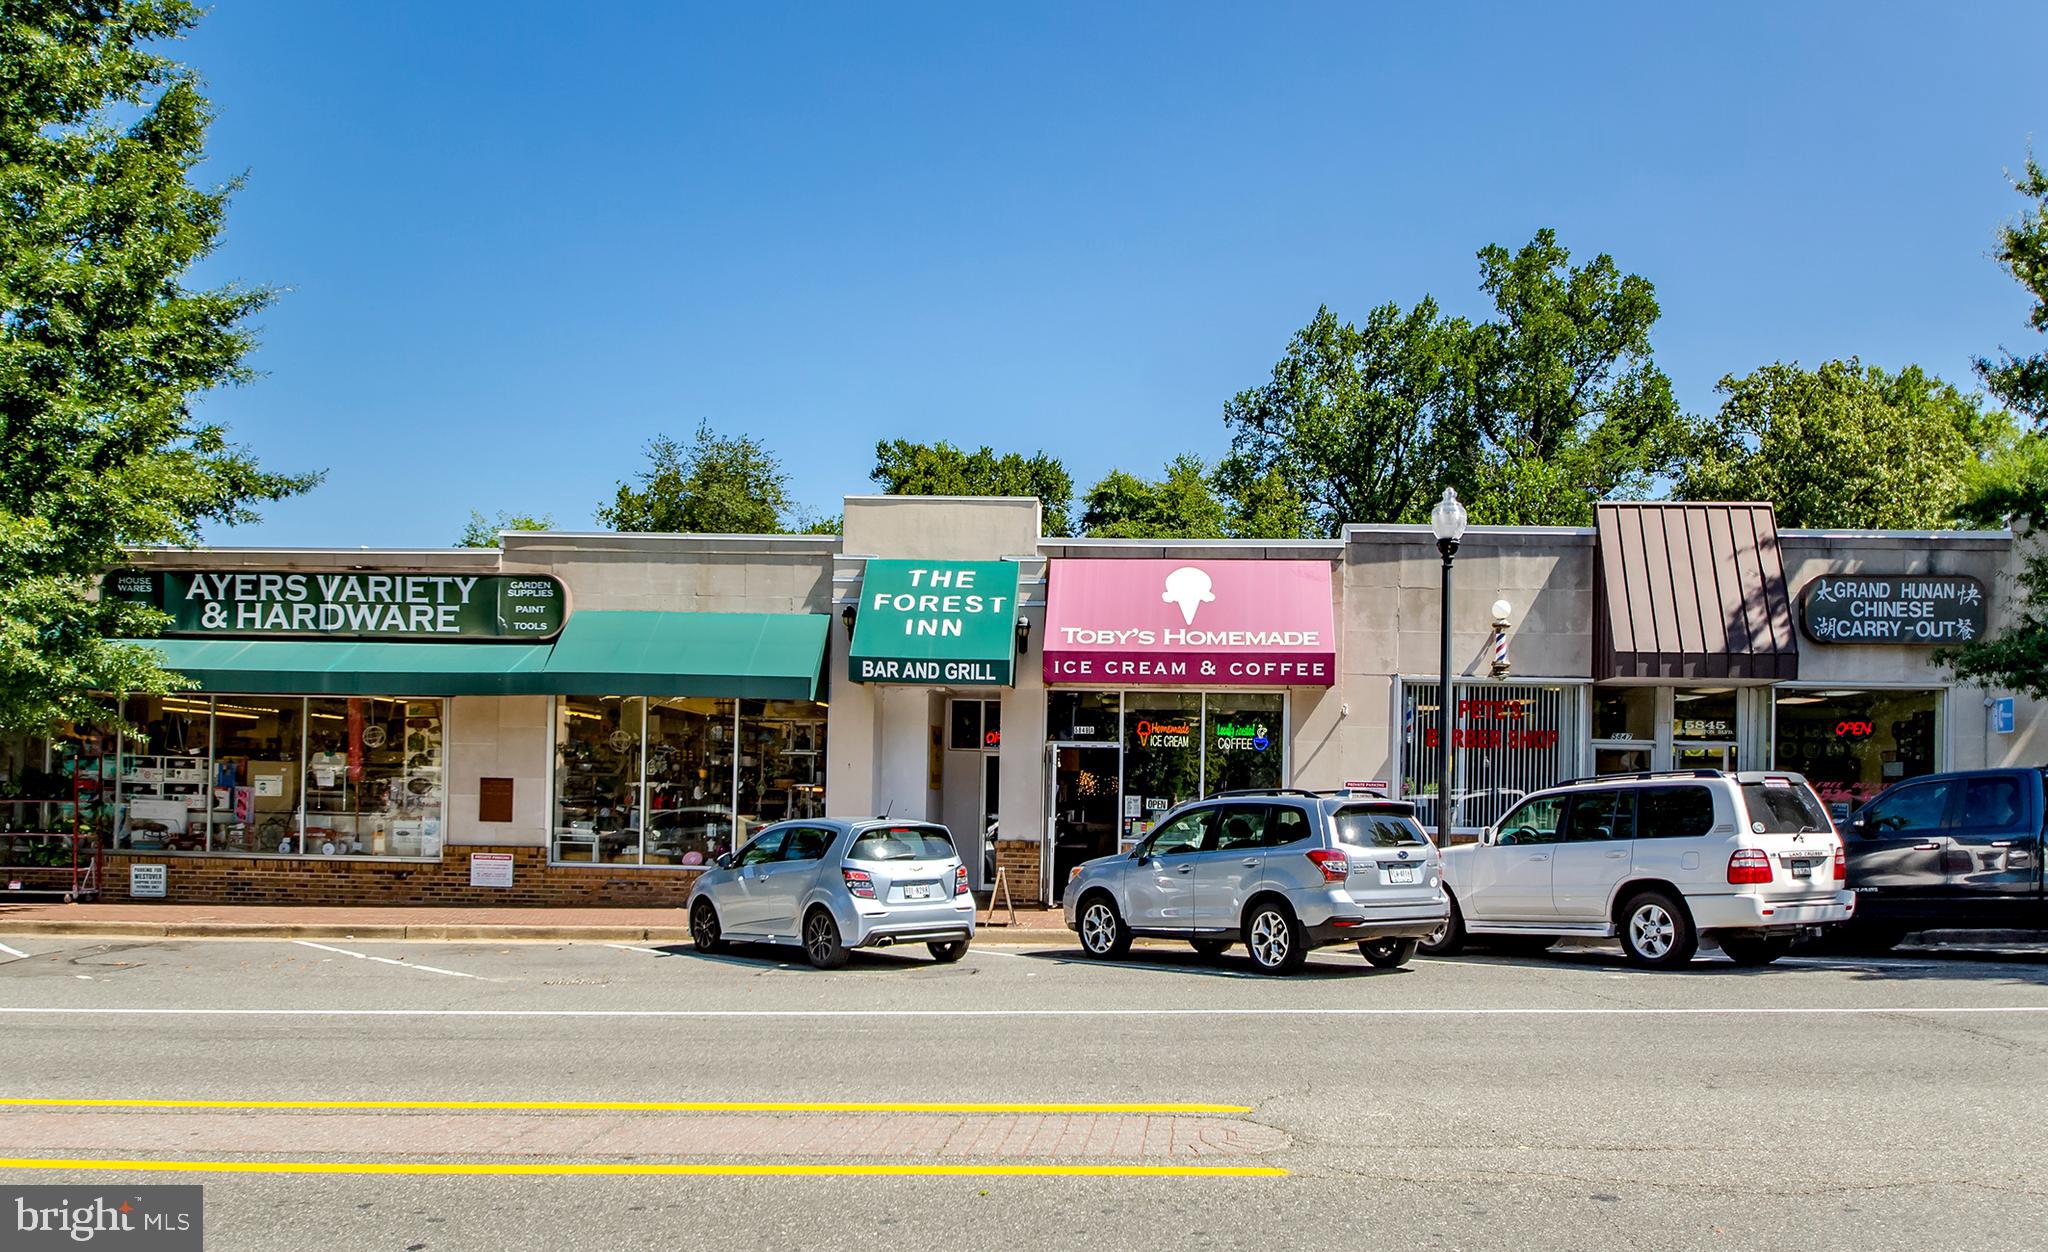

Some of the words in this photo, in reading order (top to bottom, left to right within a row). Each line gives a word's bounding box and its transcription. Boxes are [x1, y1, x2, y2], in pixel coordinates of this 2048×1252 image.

[118, 577, 152, 585] HOUSE
[510, 581, 551, 589] GARDEN
[908, 569, 977, 589] THE
[117, 585, 152, 593] WARES
[185, 574, 308, 601] AYERS
[316, 575, 479, 603] VARIETY
[507, 589, 554, 597] SUPPLIES
[1833, 582, 1891, 599] GRAND
[1901, 583, 1955, 600] HUNAN
[1957, 583, 1982, 607] 快
[515, 605, 546, 613] PAINT
[873, 593, 1008, 613] FOREST
[1850, 601, 1935, 618] CHINESE
[201, 602, 227, 629] &
[236, 602, 460, 633] HARDWARE
[513, 622, 548, 630] TOOLS
[905, 618, 963, 637] INN
[1814, 616, 1837, 640] 湖
[1060, 627, 1156, 646] TOBY'S
[1164, 628, 1320, 647] HOMEMADE
[862, 660, 900, 678] BAR
[902, 662, 941, 679] AND
[944, 662, 997, 680] GRILL
[1054, 660, 1093, 674] ICE
[1104, 661, 1186, 675] CREAM
[1200, 660, 1216, 676] &
[1229, 662, 1326, 677] COFFEE
[1458, 699, 1522, 720] PETE'S
[1151, 721, 1190, 735] Homemade
[1684, 720, 1727, 730] 5845
[1835, 721, 1873, 736] OPEN
[1150, 735, 1163, 748] ICE
[1163, 736, 1190, 748] CREAM
[1217, 737, 1253, 750] COFFEE
[1426, 728, 1501, 750] BRBER
[1508, 729, 1560, 750] SHOP
[1147, 799, 1166, 809] OPEN
